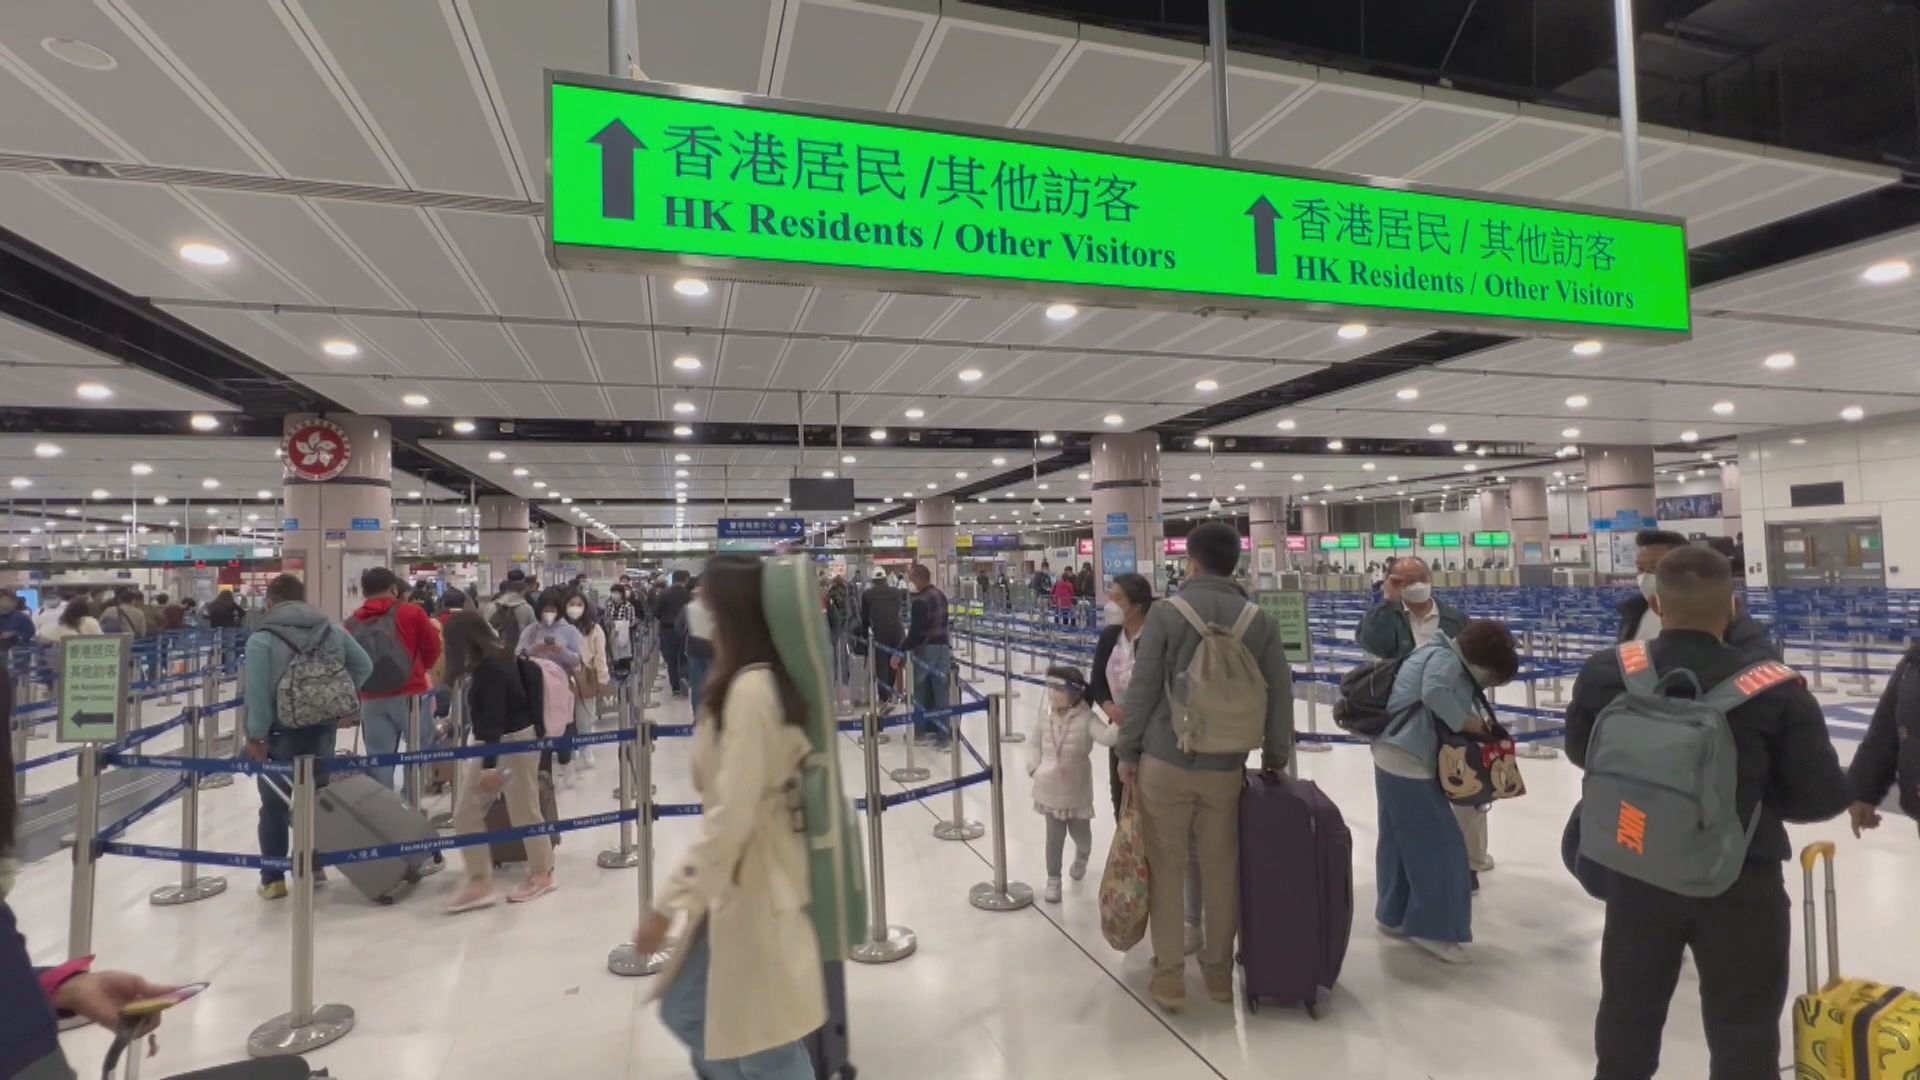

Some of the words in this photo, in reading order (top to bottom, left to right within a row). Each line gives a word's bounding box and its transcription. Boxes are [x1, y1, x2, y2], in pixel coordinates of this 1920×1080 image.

[662, 124, 1140, 224] 香港居民/其他訪客
[664, 194, 735, 233] HK
[748, 200, 925, 250] Residents
[934, 220, 945, 251] /
[955, 223, 1053, 260] Other
[1059, 232, 1177, 270] Visitors
[1294, 254, 1340, 284] HK
[1349, 258, 1464, 295] Residents
[1470, 271, 1478, 295] /
[1484, 273, 1550, 301] Other
[1555, 278, 1635, 309] Visitors
[400, 750, 454, 762] Immigration
[571, 732, 618, 744] Immigration
[400, 839, 455, 852] Immigration
[573, 814, 620, 827] Immigration
